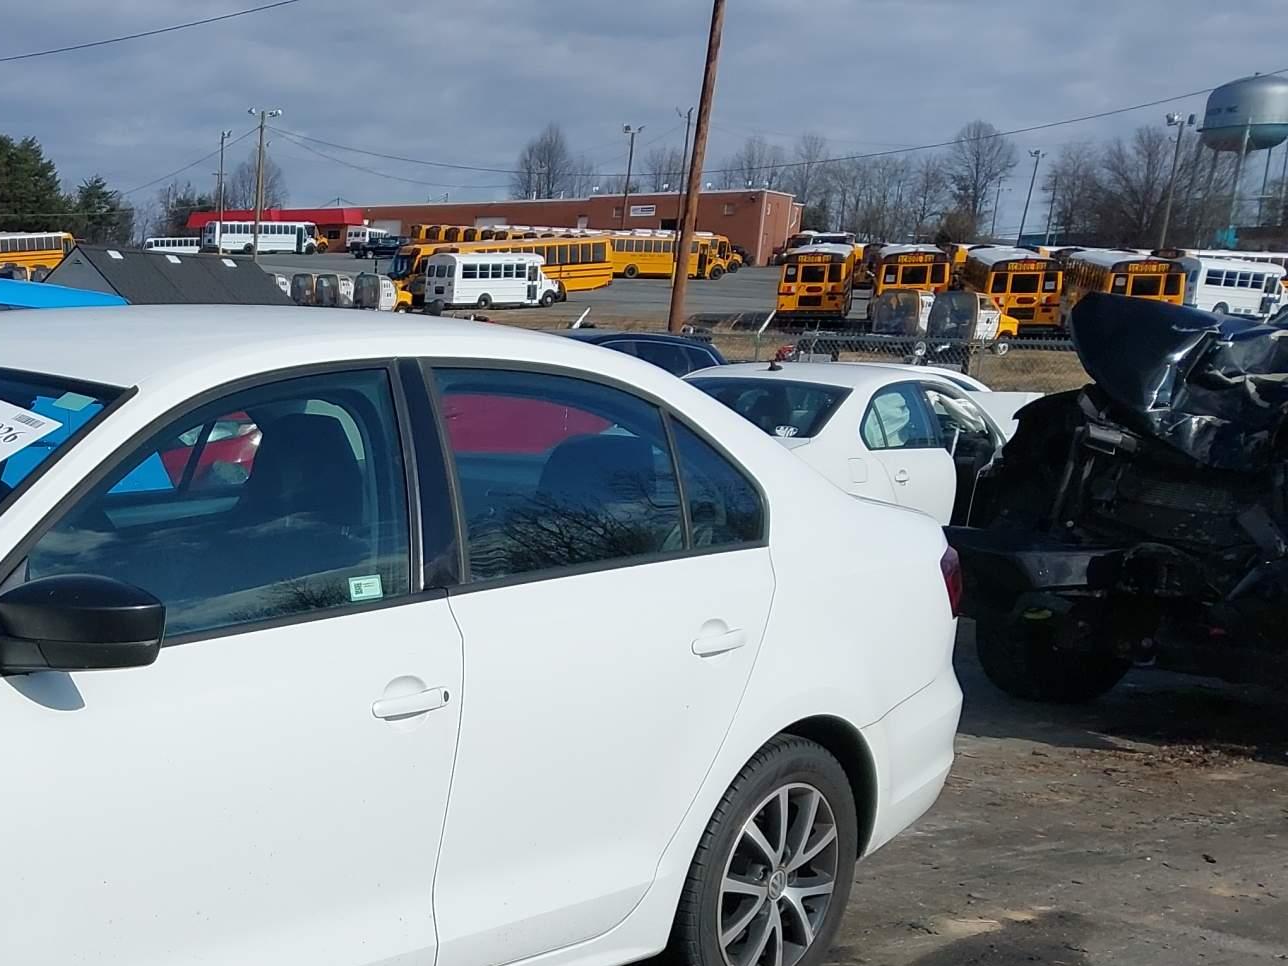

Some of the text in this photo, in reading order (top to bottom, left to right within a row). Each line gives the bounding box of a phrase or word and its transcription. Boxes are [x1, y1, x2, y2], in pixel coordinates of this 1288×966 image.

[898, 255, 923, 263] SCHOOL
[1008, 262, 1047, 270] SCHOOL BUS
[1128, 263, 1169, 272] SCHOOL BUS
